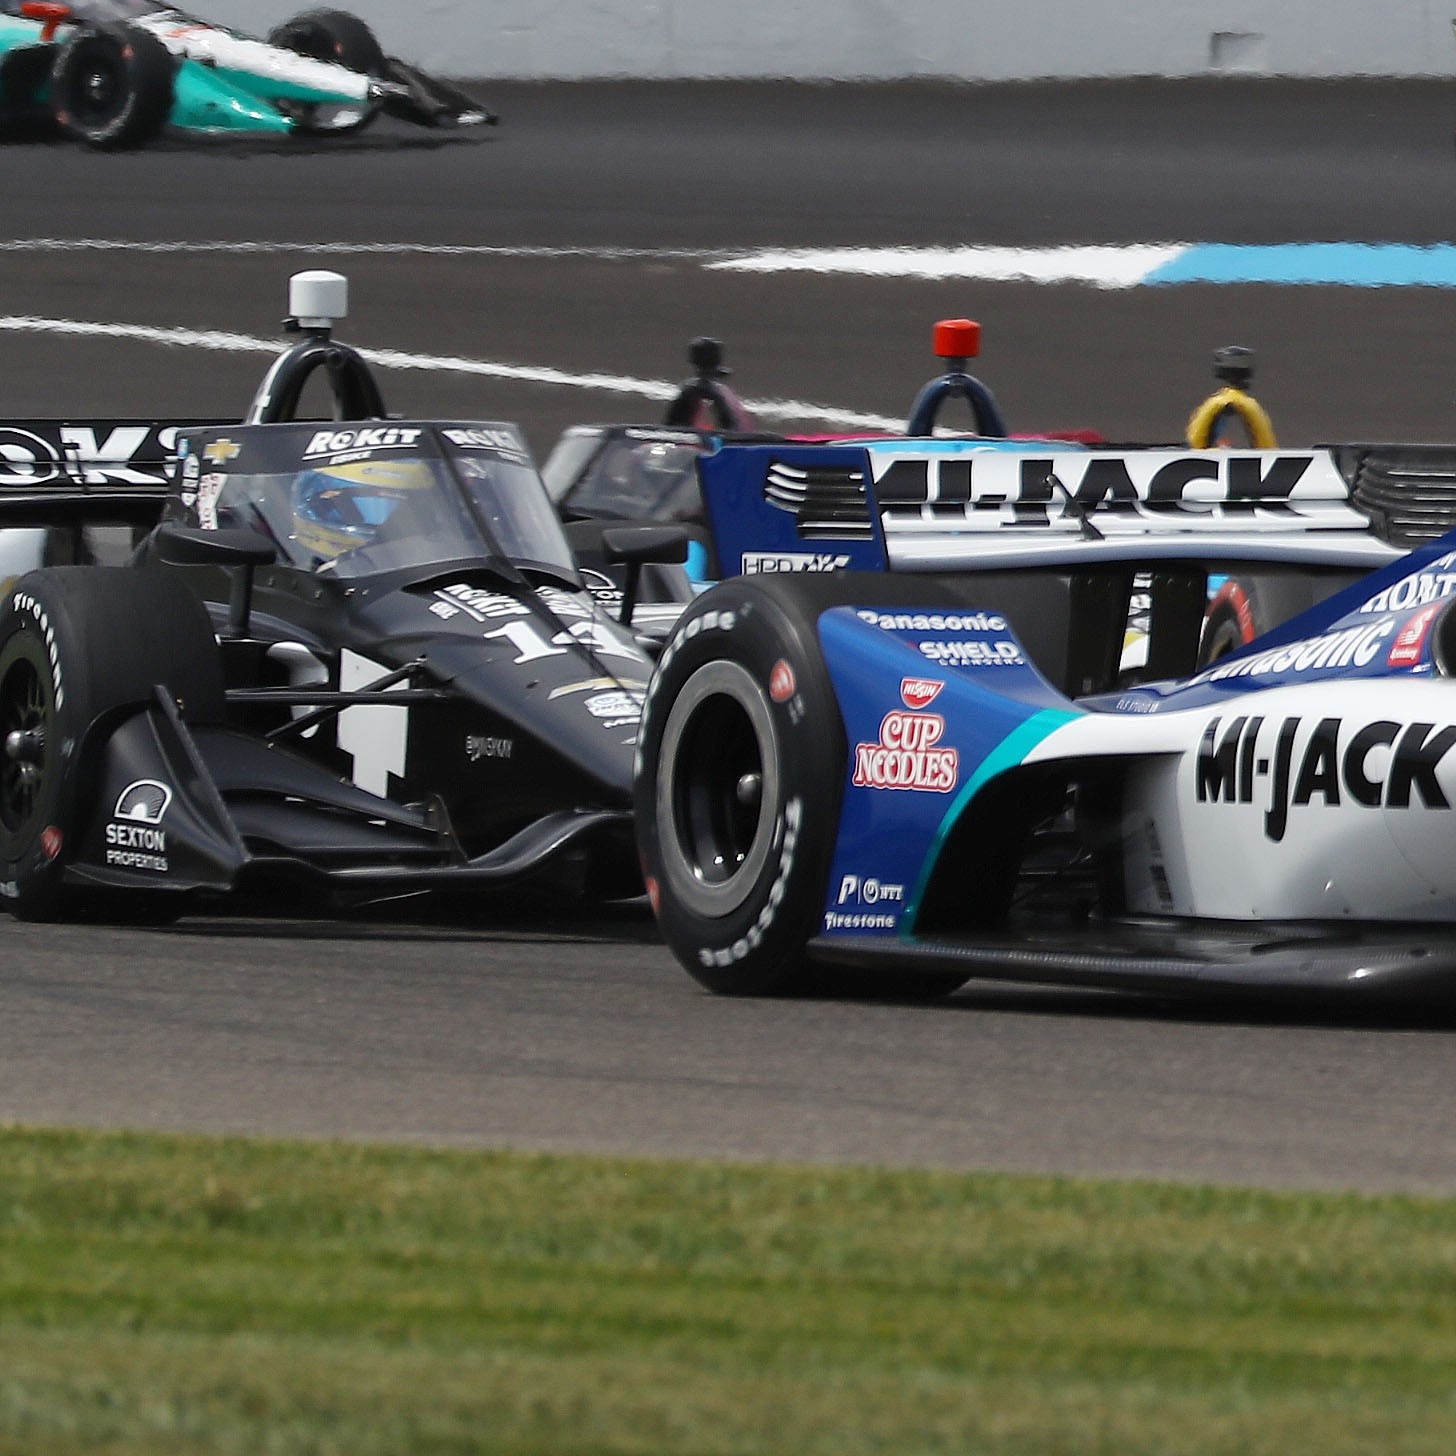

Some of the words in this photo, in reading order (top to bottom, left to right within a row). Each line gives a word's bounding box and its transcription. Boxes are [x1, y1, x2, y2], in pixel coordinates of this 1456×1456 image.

[856, 610, 1008, 631] Panasonic
[484, 620, 645, 664] 14
[918, 641, 1020, 659] SHIELD
[903, 681, 937, 698] NISSIN
[881, 714, 941, 751] CUP
[855, 747, 956, 788] NOODLES
[106, 823, 166, 852] SEXTON
[106, 850, 168, 871] PROPERTIES
[824, 911, 896, 931] Firestone
